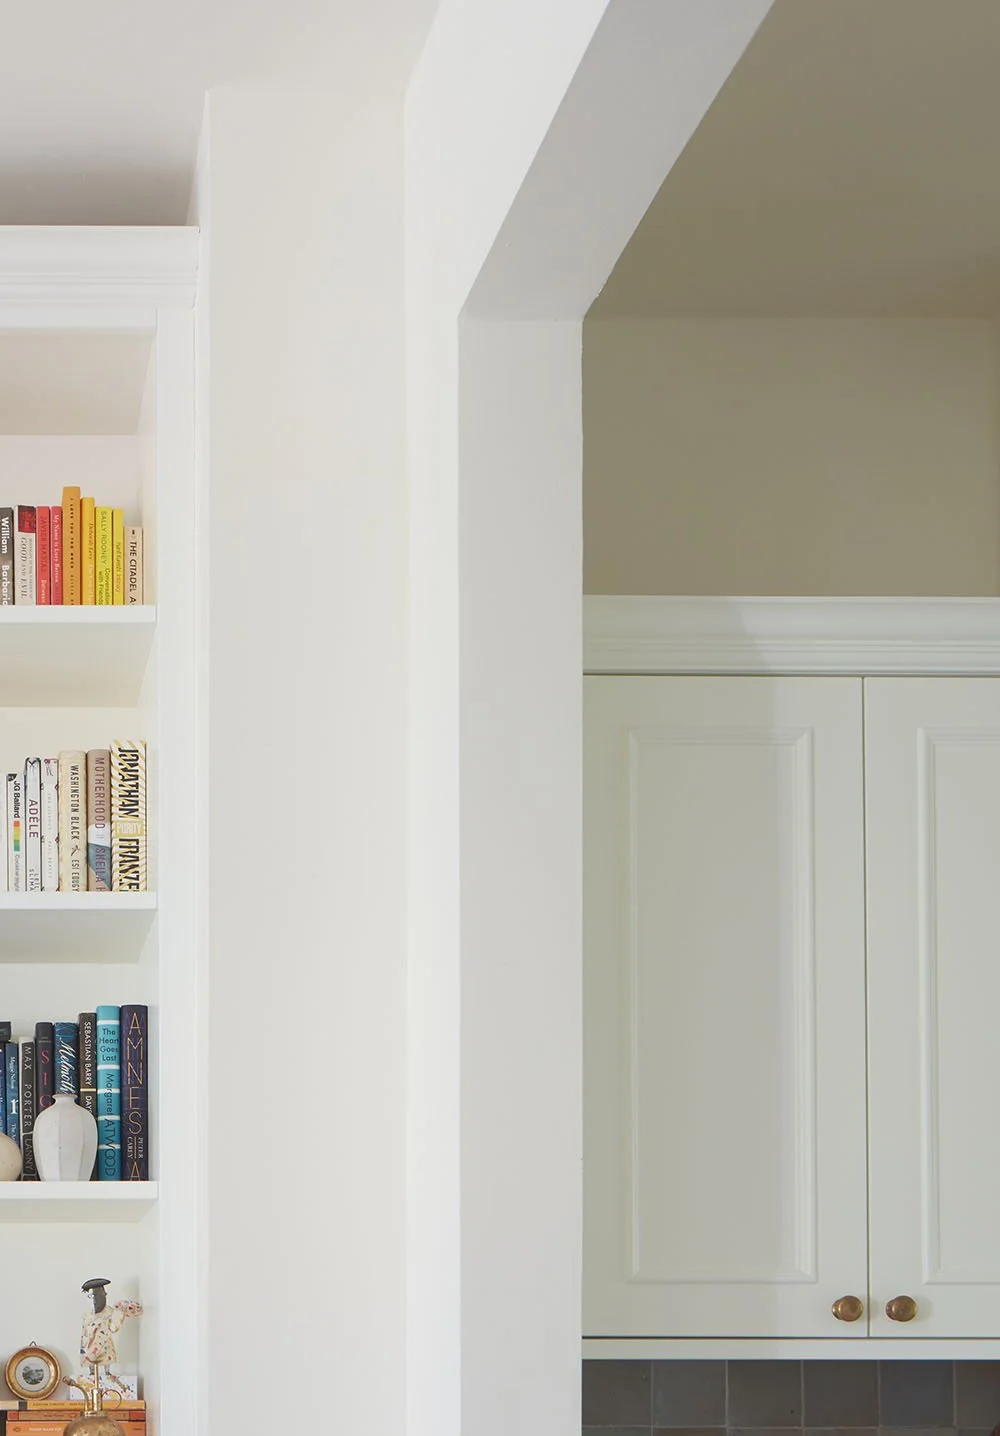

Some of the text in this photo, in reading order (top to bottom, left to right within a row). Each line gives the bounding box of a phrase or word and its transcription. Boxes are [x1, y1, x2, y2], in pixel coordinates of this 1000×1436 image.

[2, 517, 10, 554] William
[129, 541, 137, 592] THE CITADEL
[14, 780, 20, 792] JG
[70, 764, 80, 840] WASHINGTON BLACK
[94, 757, 105, 829] MOTHERHOOD
[118, 748, 140, 818] JONATHAN
[95, 848, 106, 883] SHEILA
[24, 1046, 32, 1127] MAX PORTER
[58, 1038, 76, 1093] Melmoth
[102, 1073, 116, 1176] Margaret ATWOOD
